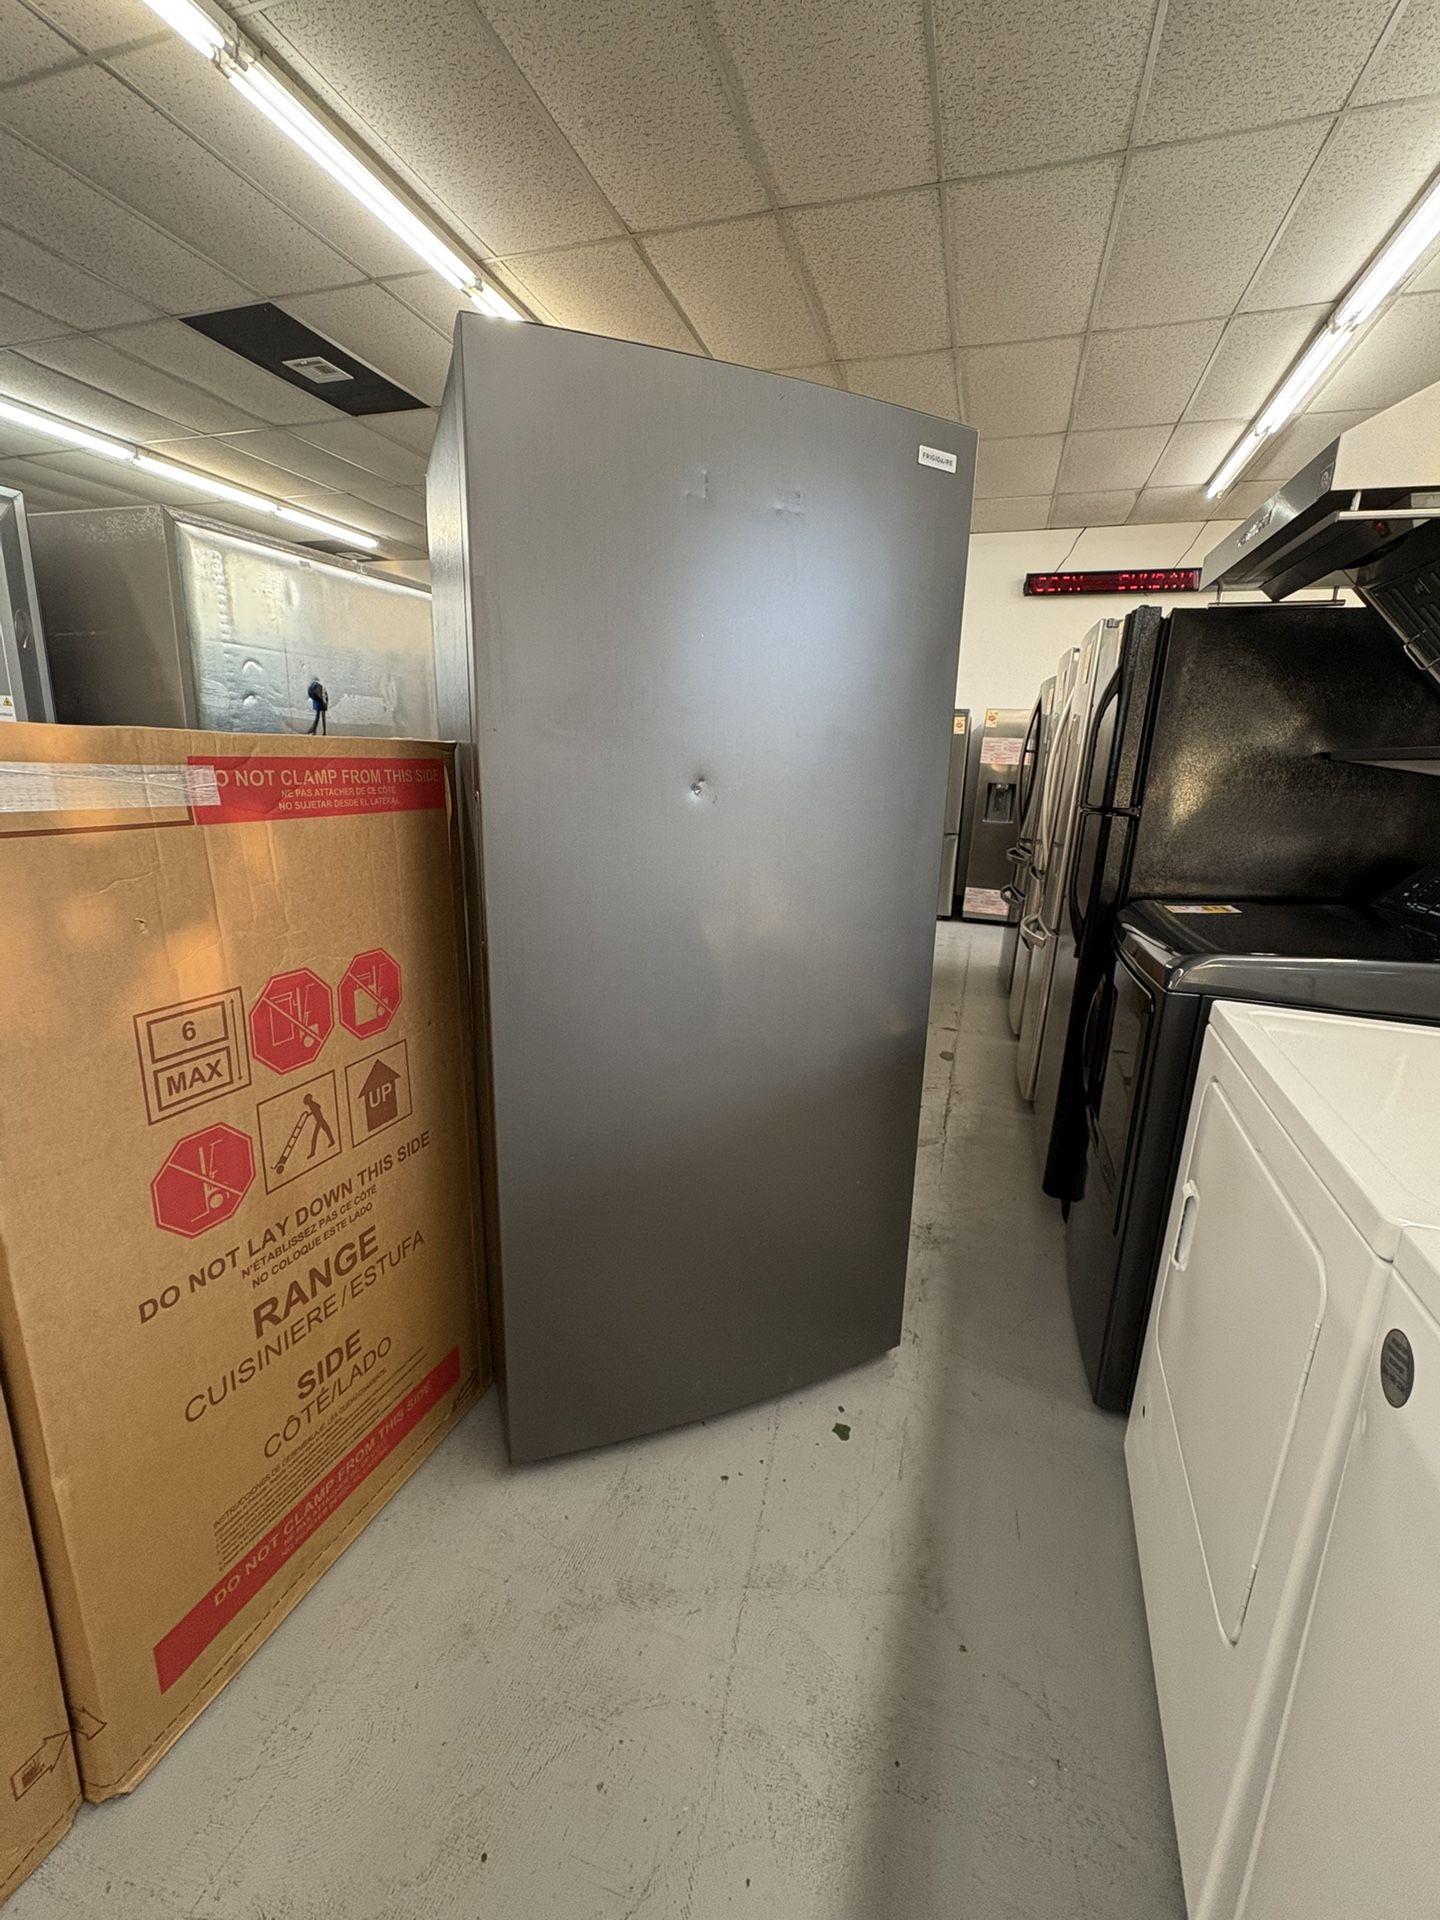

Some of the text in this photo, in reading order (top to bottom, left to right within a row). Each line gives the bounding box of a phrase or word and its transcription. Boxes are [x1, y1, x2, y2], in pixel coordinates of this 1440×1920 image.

[235, 769, 275, 786] NOT
[281, 769, 337, 785] CLAMP
[341, 769, 382, 784] FROM
[384, 768, 412, 783] THIS
[415, 768, 439, 783] SIDE
[295, 788, 312, 798] PAS
[314, 787, 355, 797] ATTACHER
[279, 801, 292, 810] NO
[295, 800, 334, 809] SUJETAR
[181, 1020, 197, 1042] 6
[165, 1058, 224, 1098] MAX
[368, 1082, 393, 1108] UP
[138, 1130, 431, 1325] DO NOT LAY DOWN THIS SIDE
[319, 1210, 338, 1229] PAS
[340, 1201, 352, 1215] CE
[252, 1201, 374, 1289] NO COLOQUE ESTE LADO
[253, 1224, 379, 1340] RANGE
[297, 1328, 362, 1400] SIDE
[213, 1574, 241, 1608] DO
[244, 1534, 281, 1576] NOT
[283, 1478, 335, 1536] CLAMP
[337, 1436, 377, 1483] FROM
[377, 1409, 405, 1444] THIS
